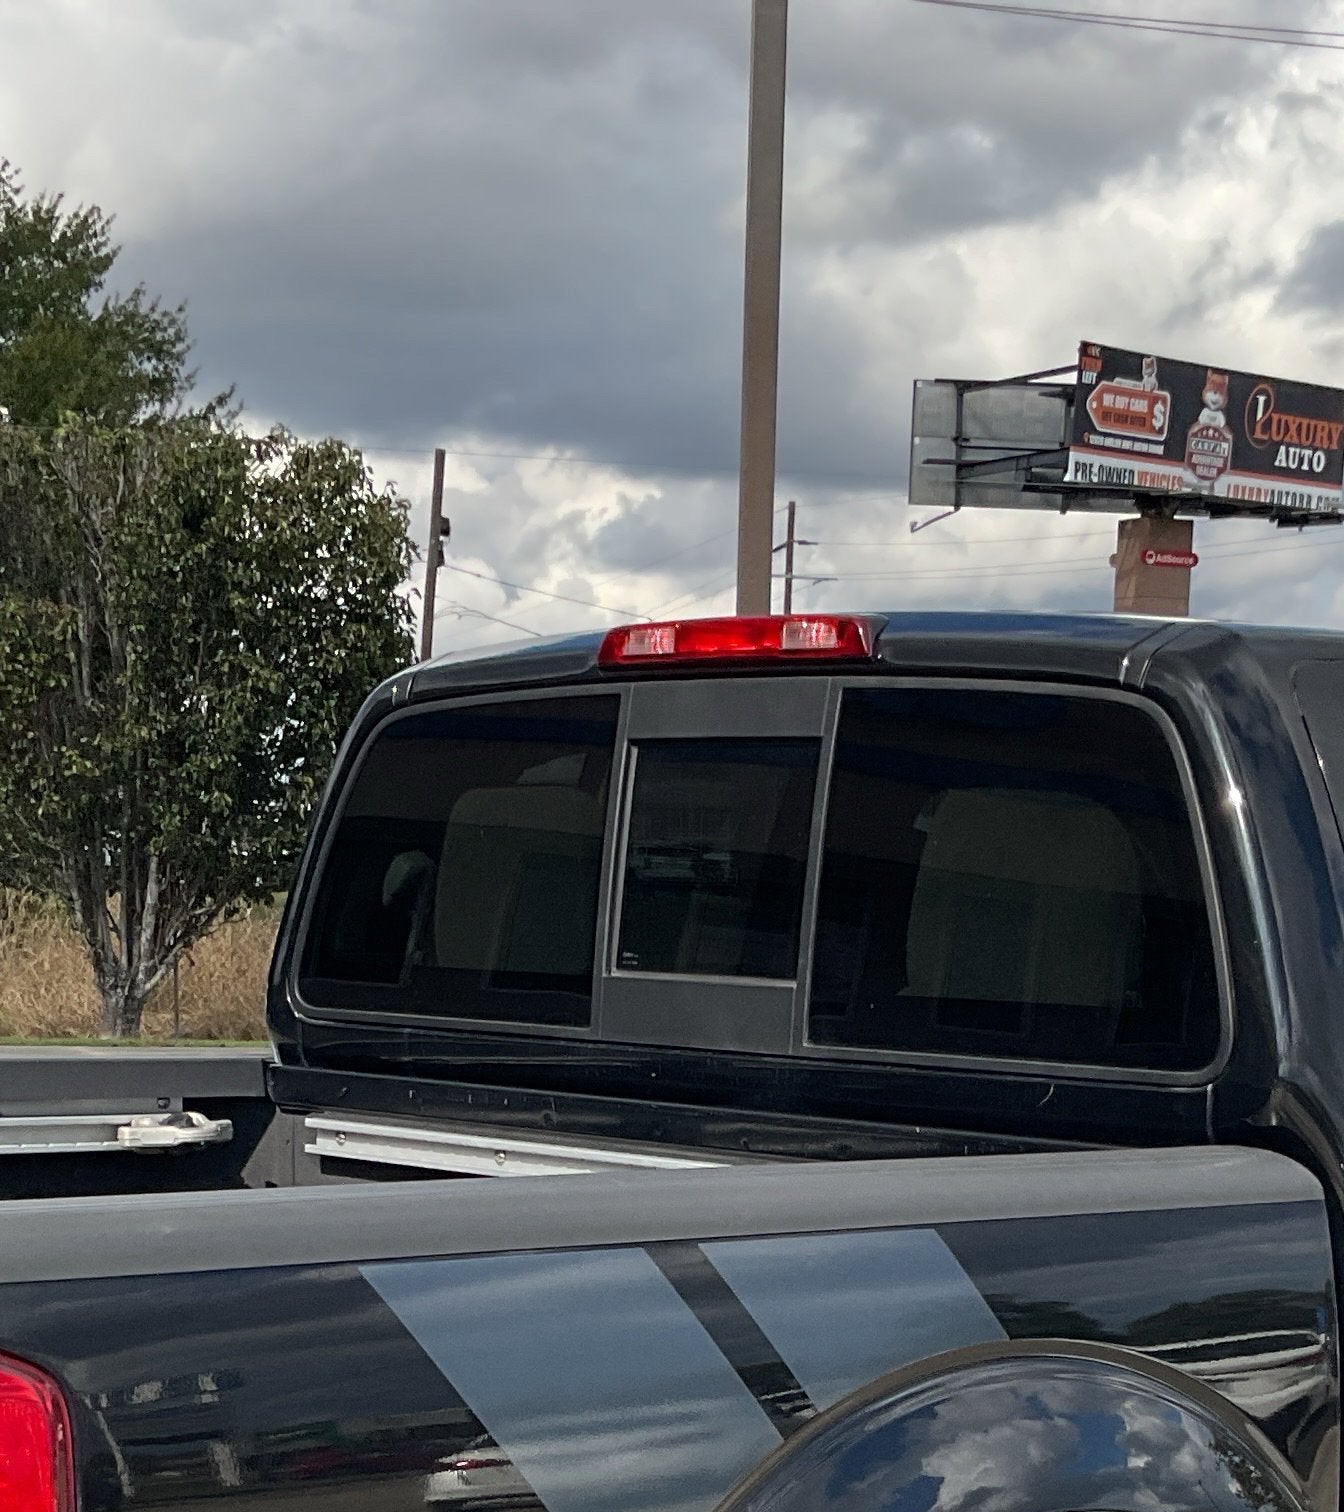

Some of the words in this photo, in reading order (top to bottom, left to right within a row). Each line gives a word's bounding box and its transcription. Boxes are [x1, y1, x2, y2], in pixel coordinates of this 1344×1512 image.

[1248, 390, 1344, 450] LUXURY
[1274, 445, 1326, 473] AUTO
[1073, 461, 1134, 485] PRE-OWNED
[1135, 470, 1184, 491] VEHICLES
